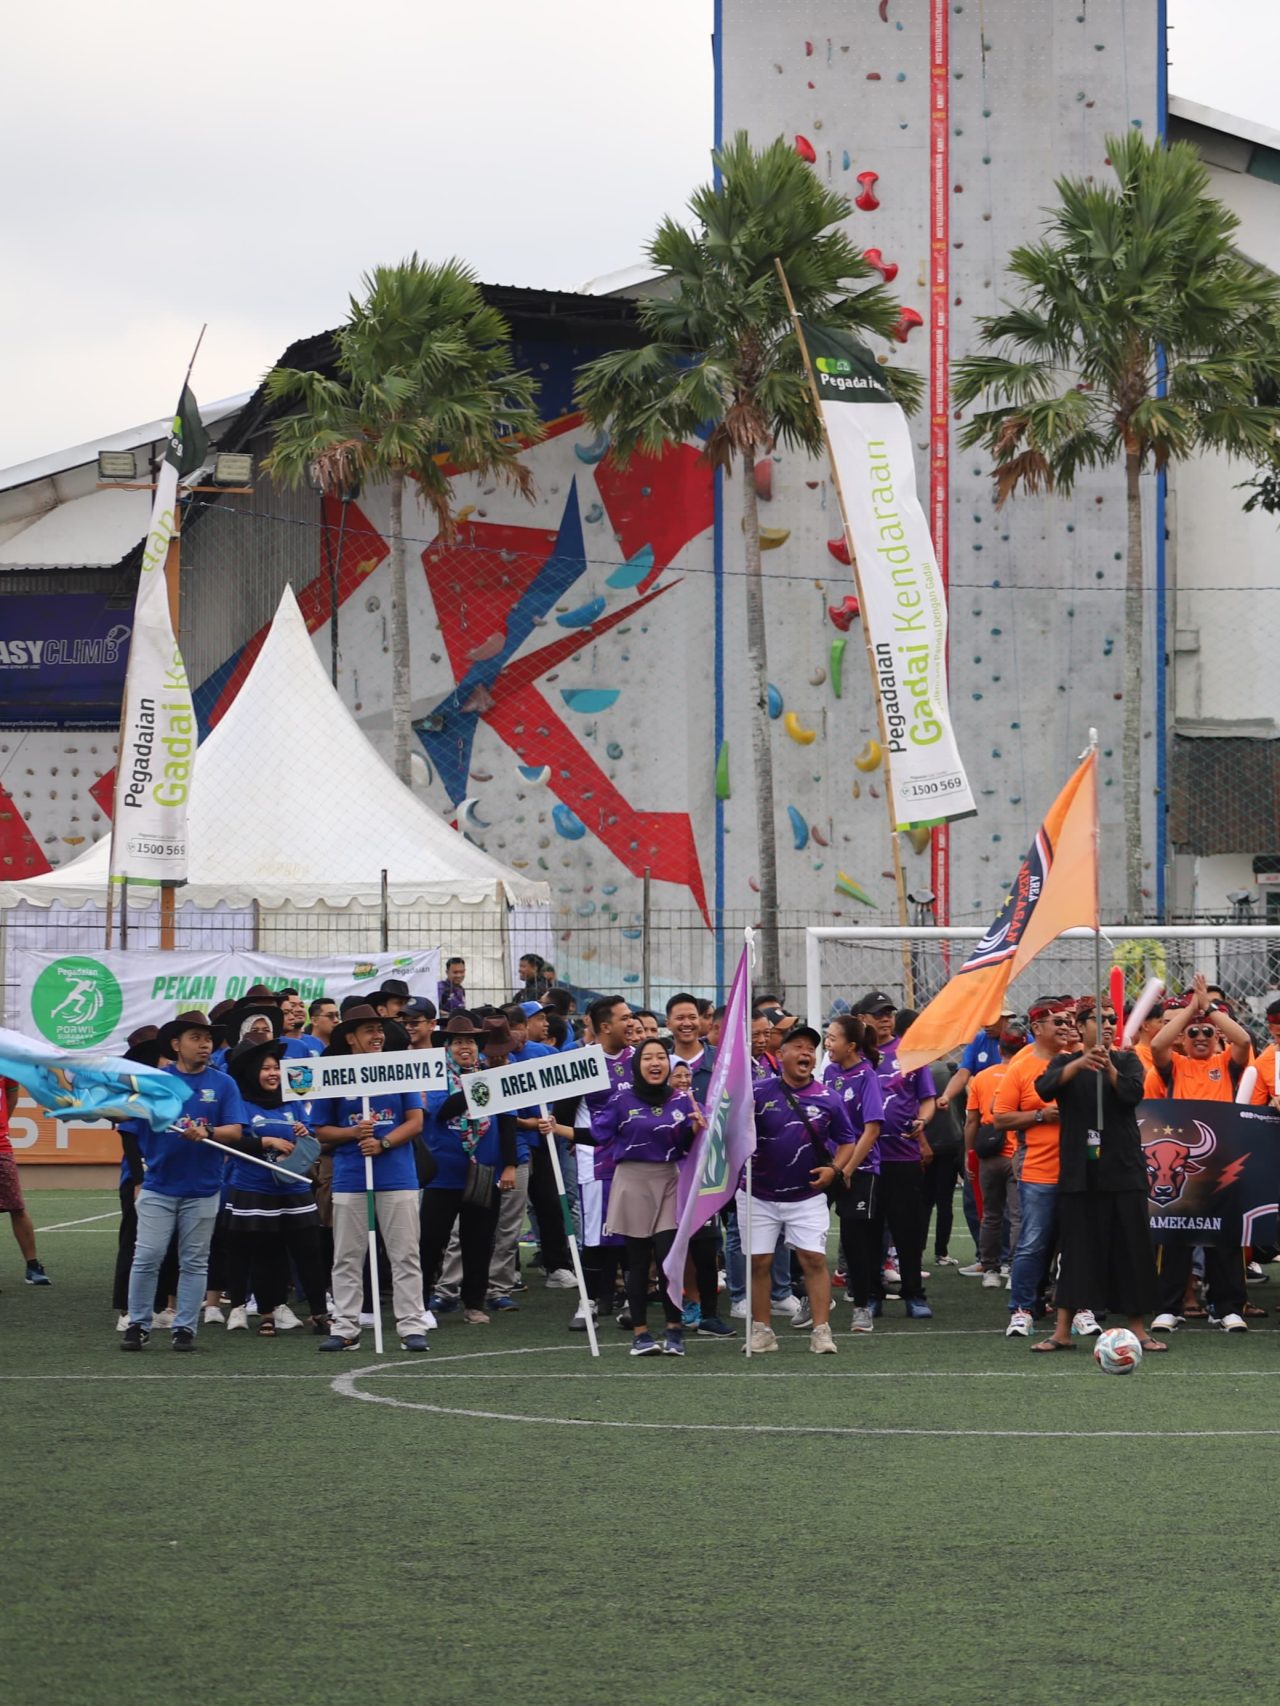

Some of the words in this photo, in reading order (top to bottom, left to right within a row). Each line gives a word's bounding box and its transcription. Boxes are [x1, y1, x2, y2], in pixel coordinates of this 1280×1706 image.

[867, 441, 927, 632] Kendaraan
[0, 640, 118, 664] ASYCLIMB
[876, 643, 906, 753] Pegadaian
[898, 643, 943, 746] Gadai
[125, 698, 156, 808] Pegadaian
[152, 703, 193, 807] Gadai
[911, 785, 938, 796] 1500
[940, 777, 962, 790] 569
[137, 843, 164, 855] 1500
[151, 976, 217, 1000] PEKAN
[322, 1068, 357, 1087] AREA
[361, 1062, 430, 1083] SURABAYA
[435, 1061, 444, 1077] 2
[500, 1072, 537, 1097] AREA
[539, 1058, 599, 1088] MALANG
[1149, 1216, 1222, 1230] AMEKASAN
